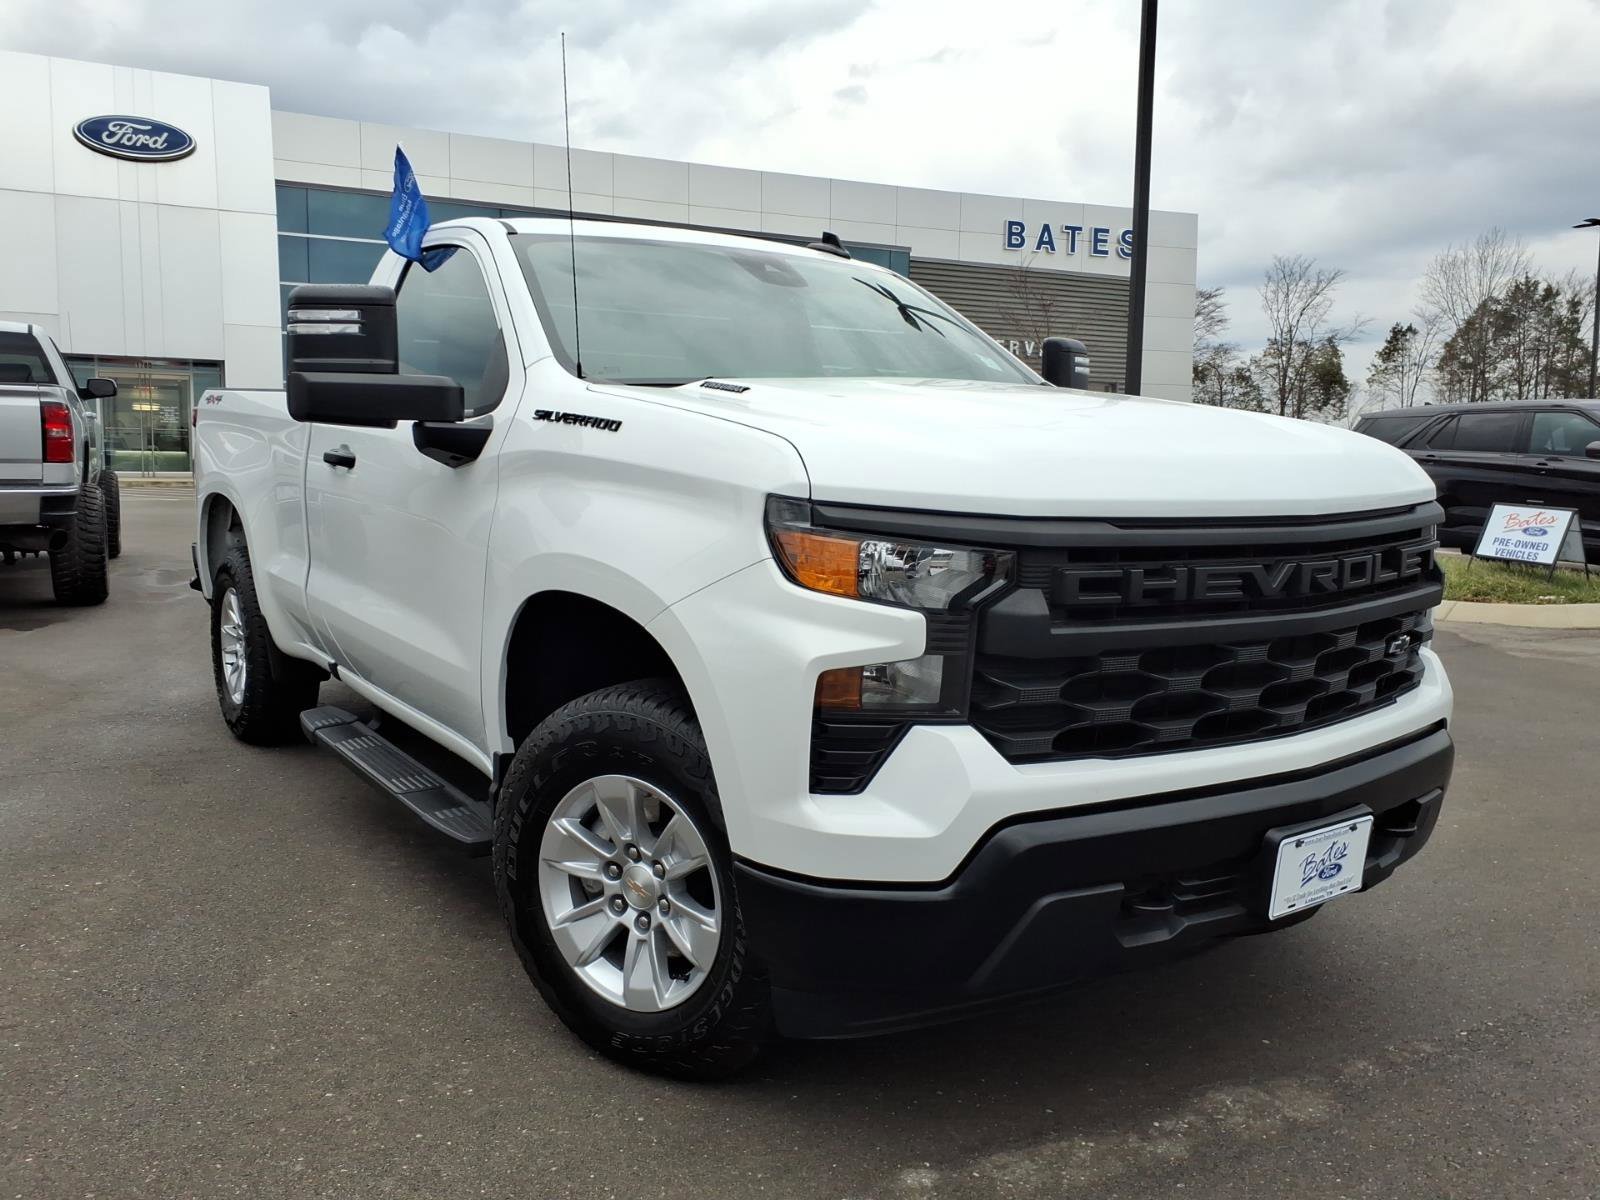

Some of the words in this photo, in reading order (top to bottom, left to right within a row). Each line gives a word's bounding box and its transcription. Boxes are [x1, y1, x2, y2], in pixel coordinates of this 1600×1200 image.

[101, 121, 168, 149] Ford
[1005, 219, 1134, 259] BATES
[532, 408, 622, 433] SILVERADO
[1503, 511, 1558, 529] Bates
[1492, 536, 1549, 552] PRE-OWNED
[1494, 547, 1540, 561] VEHICLES
[1060, 541, 1440, 606] CHEVROLET
[1299, 840, 1350, 879] Bates
